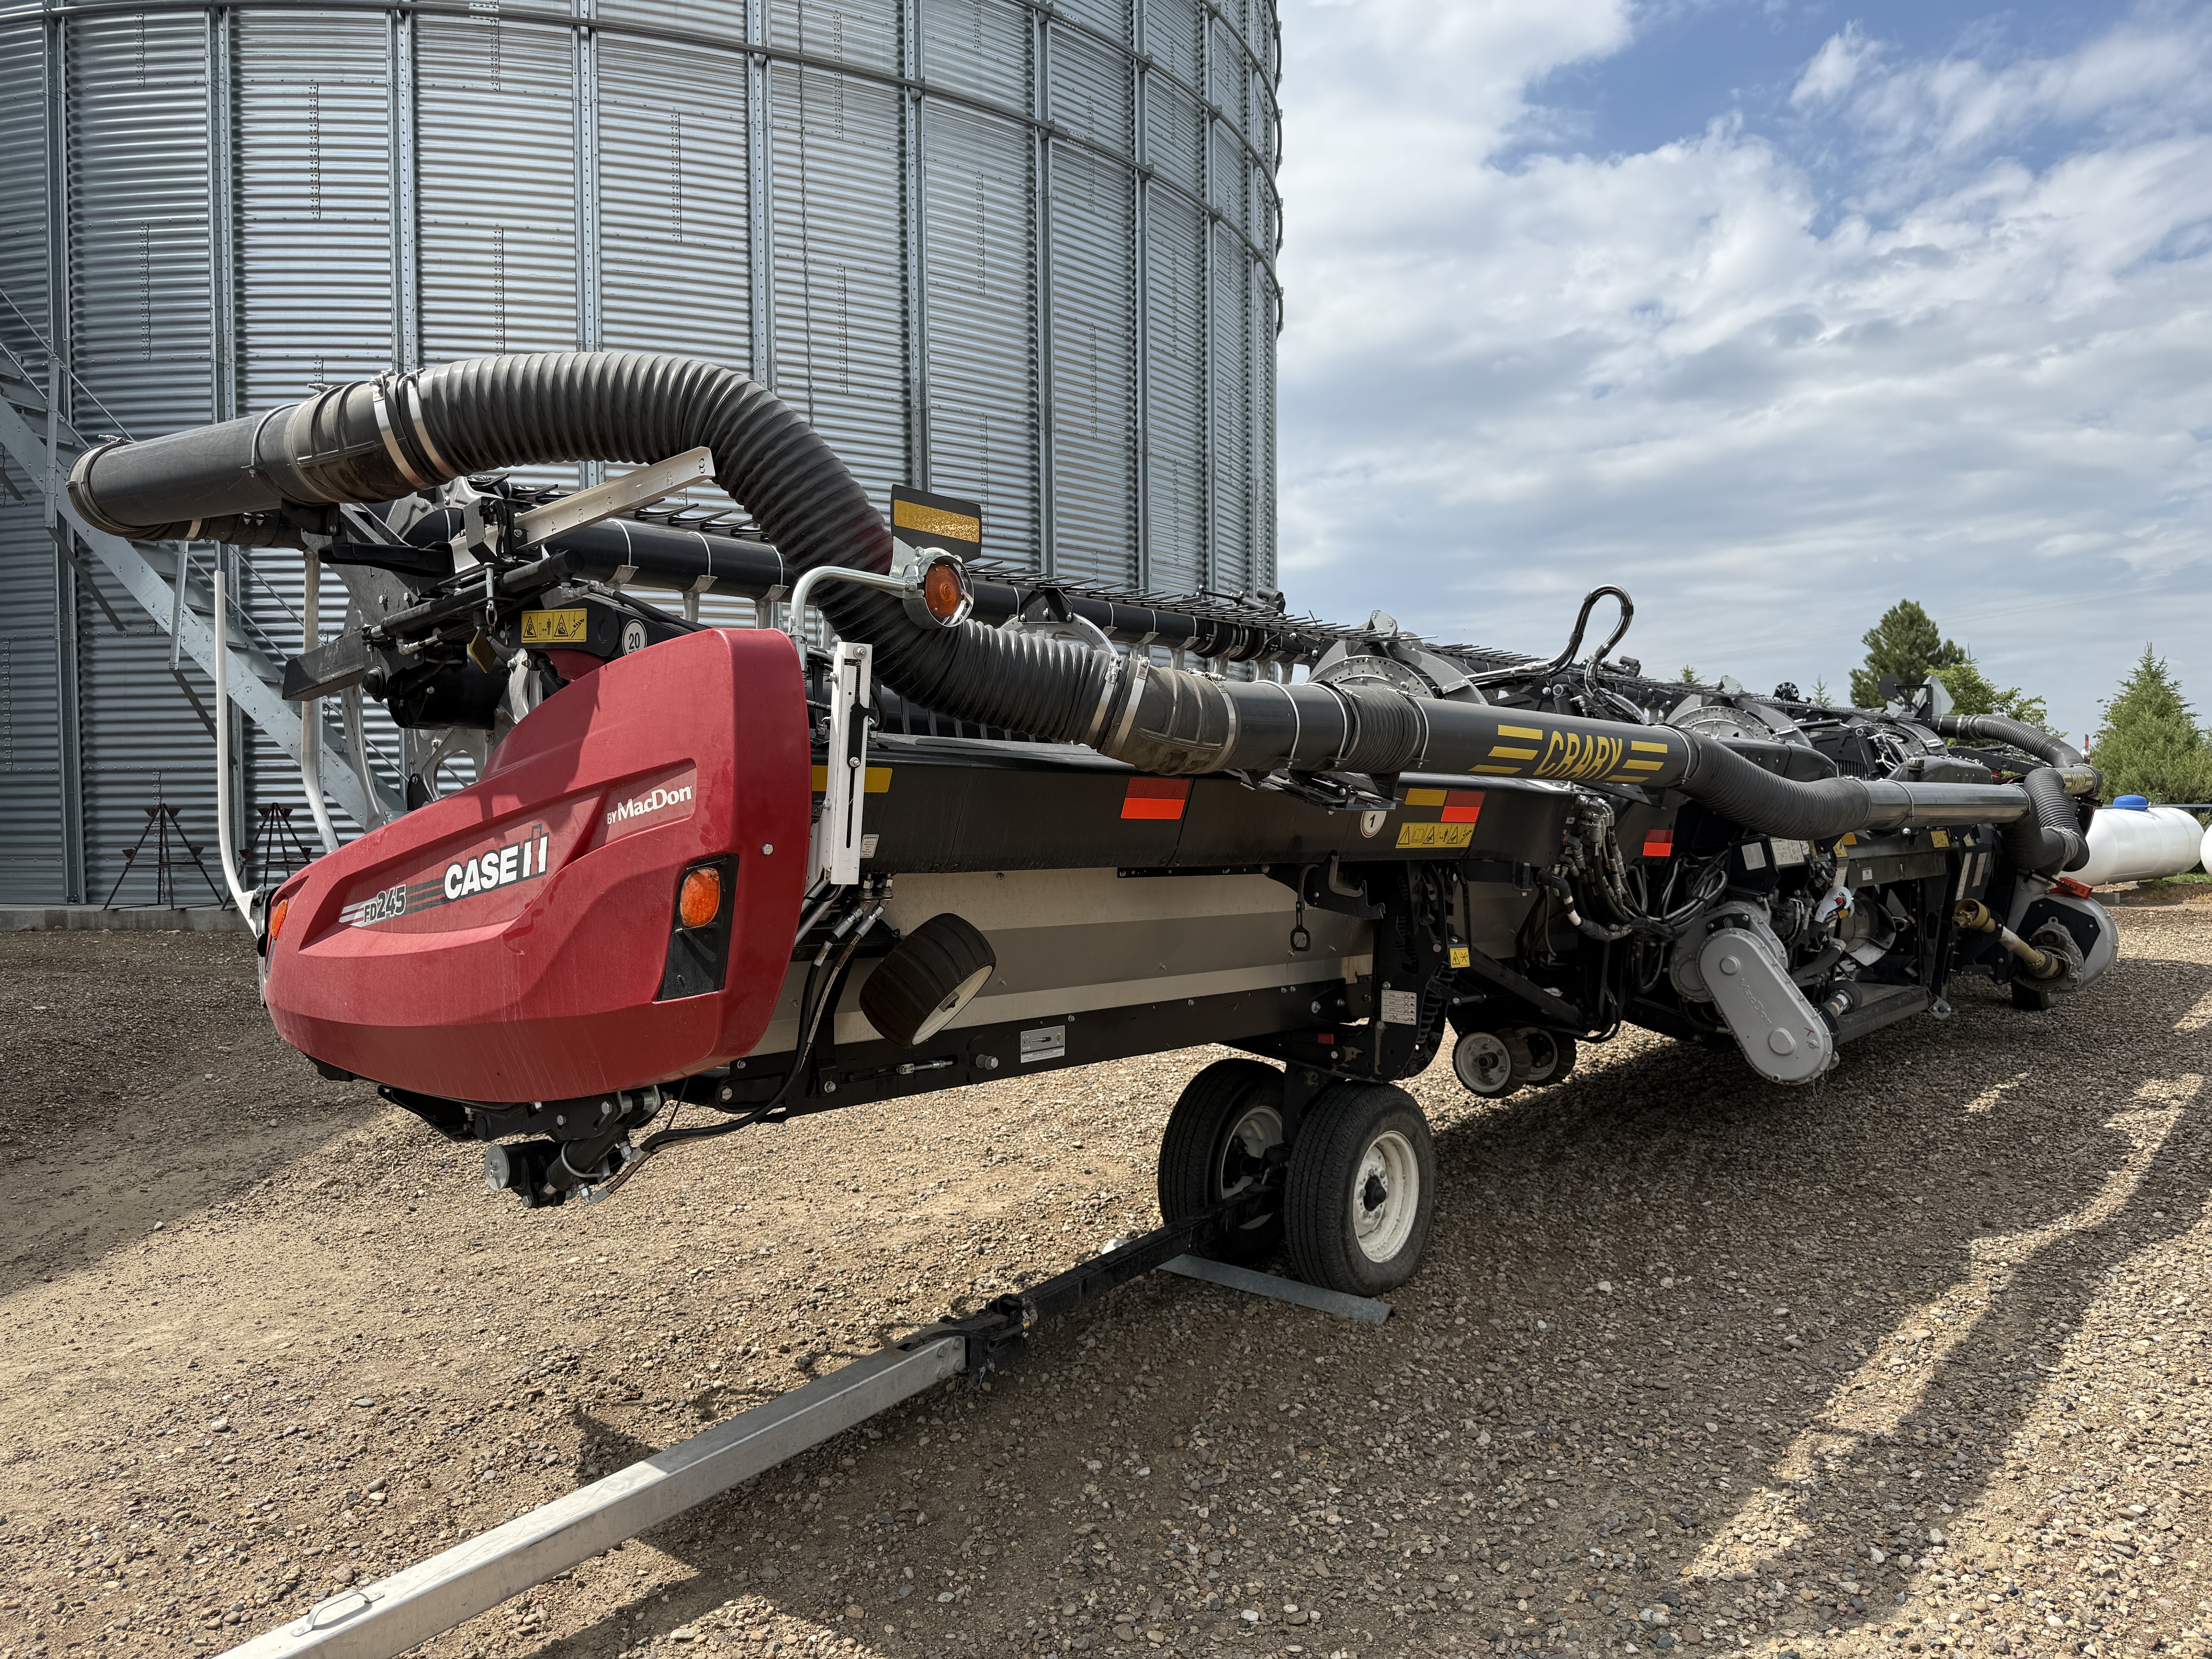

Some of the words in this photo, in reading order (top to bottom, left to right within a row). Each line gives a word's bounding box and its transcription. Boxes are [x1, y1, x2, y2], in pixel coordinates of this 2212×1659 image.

[699, 458, 705, 474] 9
[629, 632, 640, 650] 20
[1533, 730, 1623, 780] CRARY
[607, 810, 617, 824] BY
[618, 786, 692, 821] MacDon
[1370, 814, 1376, 828] 1
[444, 845, 519, 899] CASE
[363, 884, 406, 924] FD245
[1737, 977, 1772, 1026] MacDon
